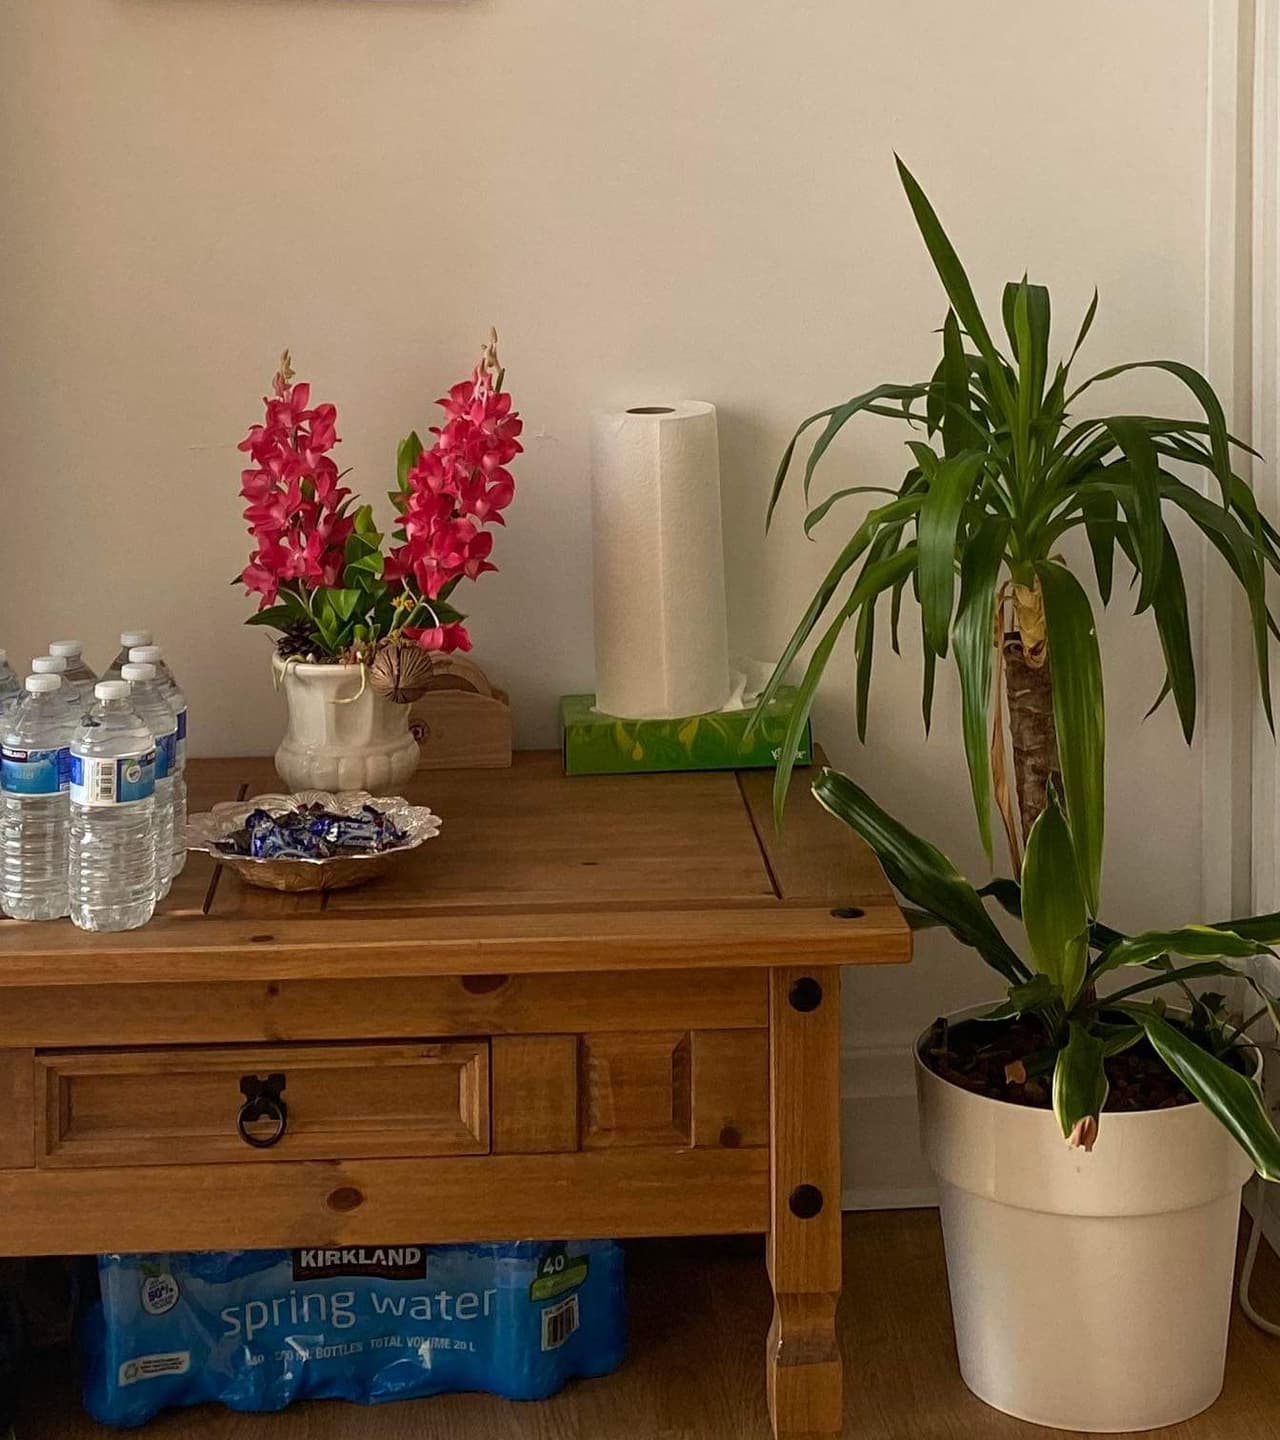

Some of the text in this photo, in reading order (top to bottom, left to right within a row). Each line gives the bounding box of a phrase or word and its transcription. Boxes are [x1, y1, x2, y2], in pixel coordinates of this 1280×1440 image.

[300, 1247, 422, 1268] KIRKLAND
[542, 1254, 566, 1275] 40
[221, 1287, 498, 1342] spring water
[315, 1340, 364, 1360] BOTTLES
[370, 1335, 404, 1350] TOTAL
[453, 1339, 468, 1351] 20
[468, 1340, 477, 1353] L
